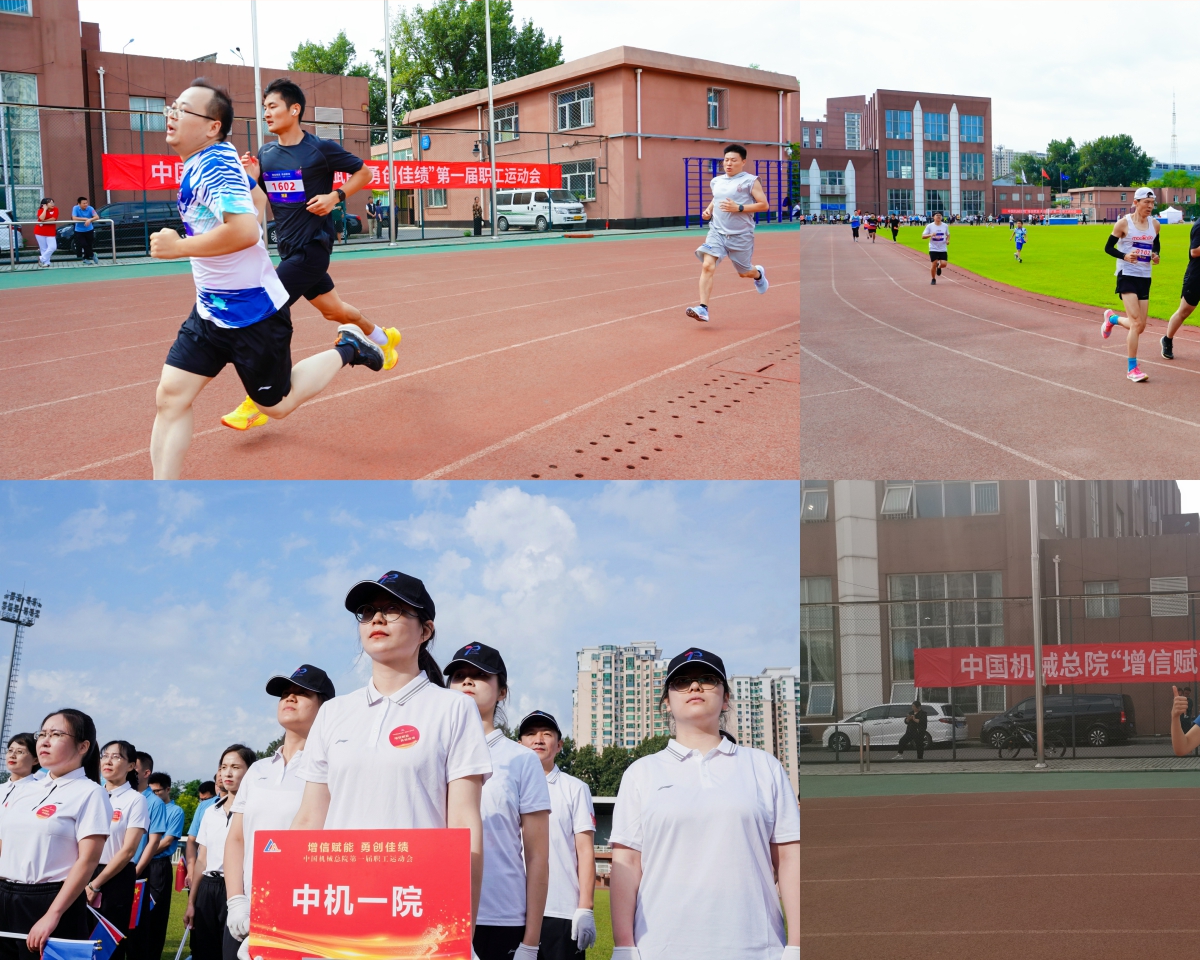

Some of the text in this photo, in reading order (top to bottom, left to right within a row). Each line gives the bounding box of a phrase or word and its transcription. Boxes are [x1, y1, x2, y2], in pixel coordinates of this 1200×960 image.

[271, 181, 296, 191] 1602
[307, 841, 410, 853] 增信赋能 勇创佳绩
[303, 855, 413, 863] 中国机械总院第一届职工运动会
[292, 883, 424, 918] 中机一院
